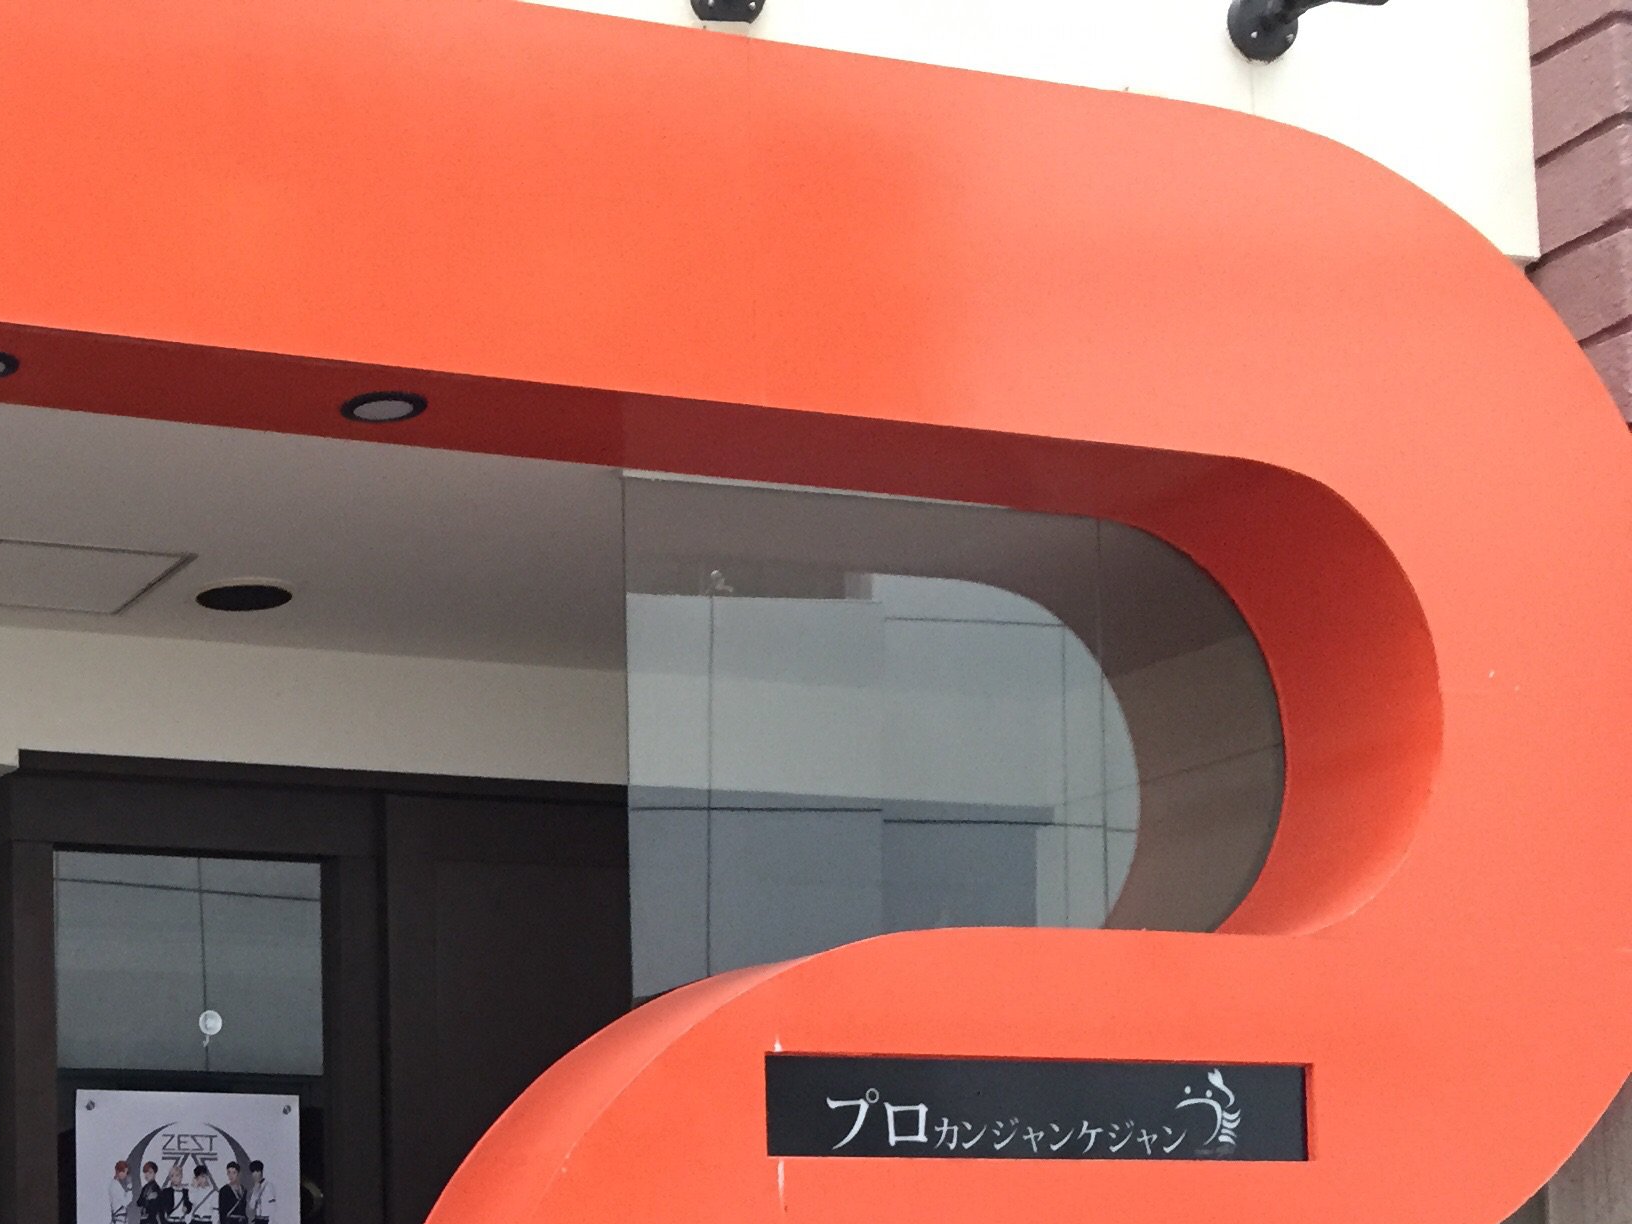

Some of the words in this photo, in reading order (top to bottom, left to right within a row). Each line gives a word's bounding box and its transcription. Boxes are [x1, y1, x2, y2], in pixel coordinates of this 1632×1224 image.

[826, 1088, 1188, 1154] プロカンジャンケジャン
